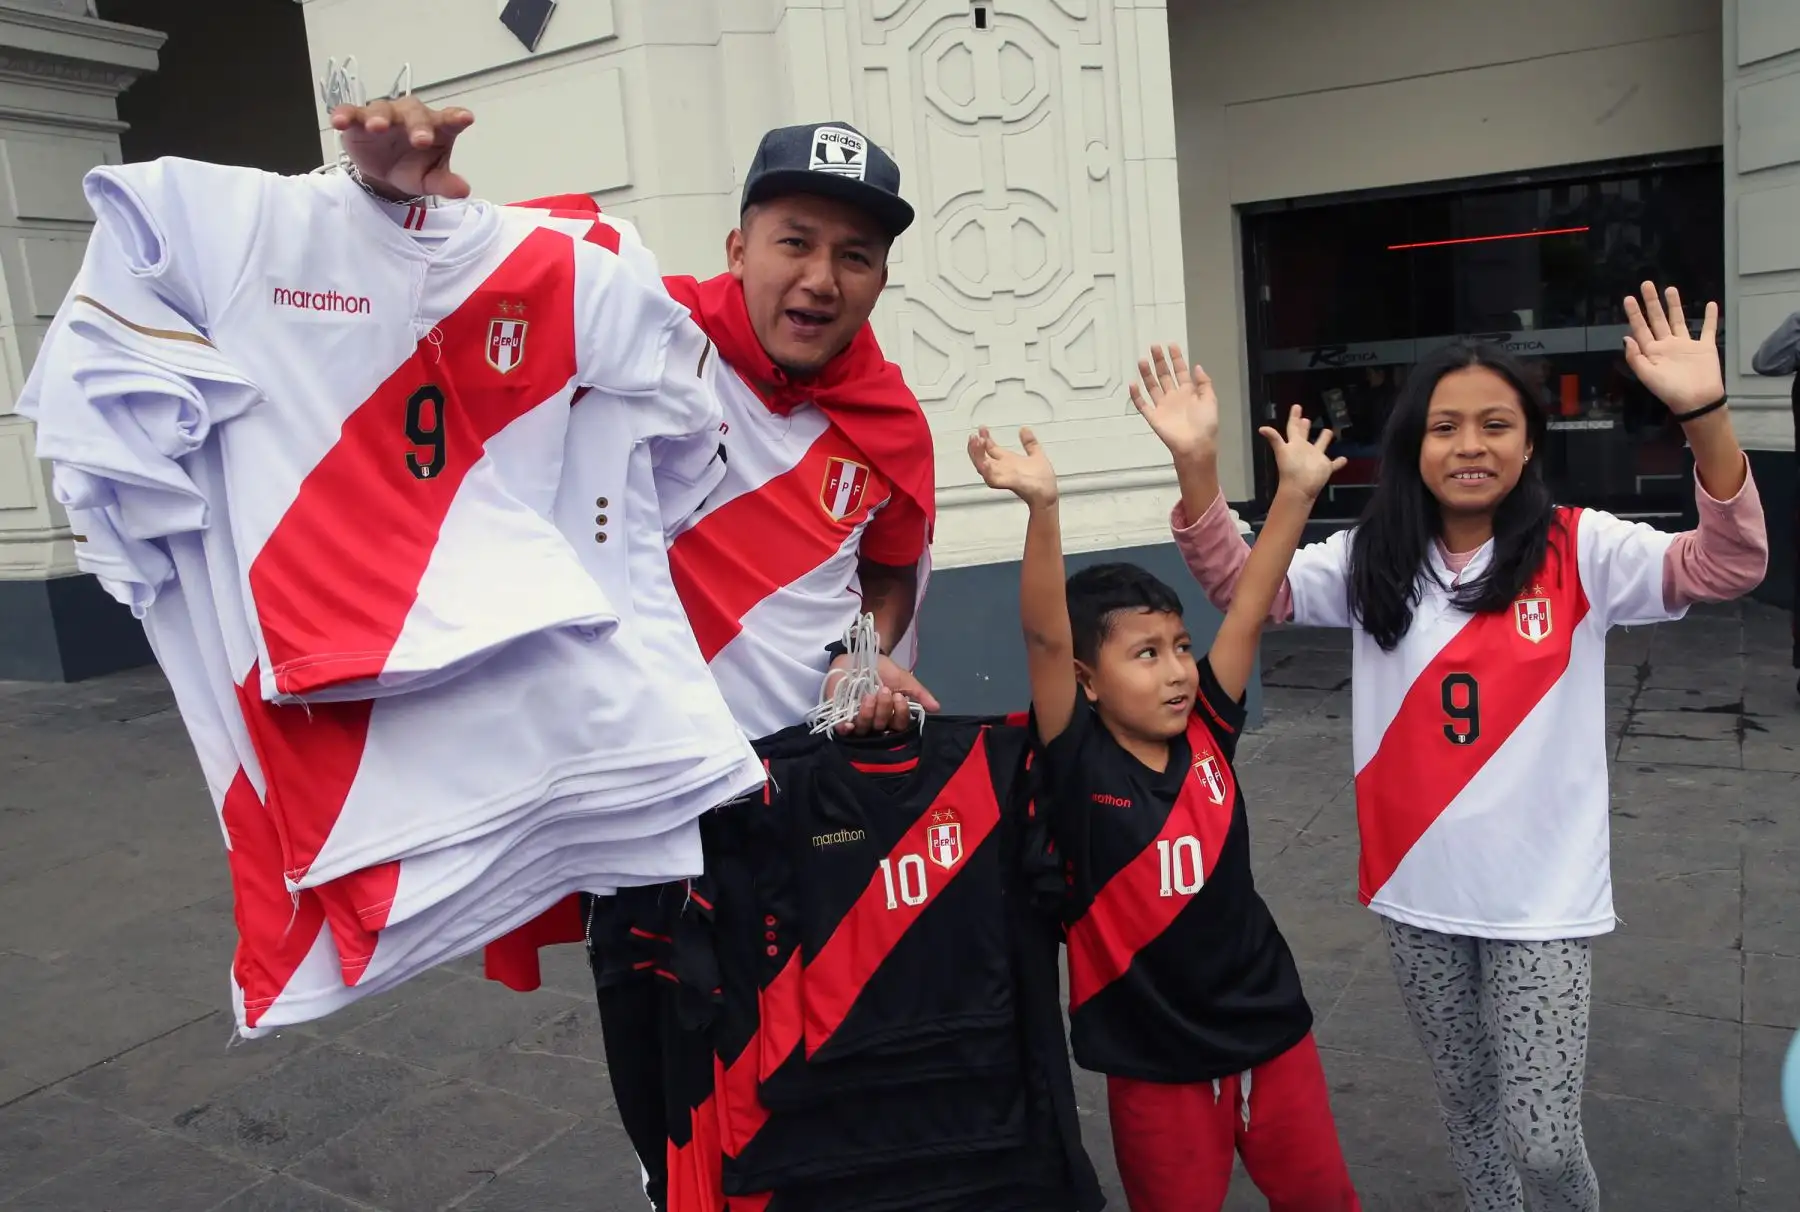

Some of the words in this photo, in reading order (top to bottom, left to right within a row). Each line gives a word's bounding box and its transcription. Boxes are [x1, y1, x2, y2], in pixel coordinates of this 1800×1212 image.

[819, 132, 863, 151] adidas
[273, 287, 371, 315] marathon
[492, 336, 519, 347] PERU
[403, 383, 447, 480] 9
[829, 478, 861, 496] FPF
[1520, 612, 1546, 622] PERU
[1440, 672, 1481, 745] 9
[812, 828, 866, 849] marathon
[932, 836, 957, 848] PERU
[1157, 834, 1205, 896] 10
[878, 853, 929, 910] 10
